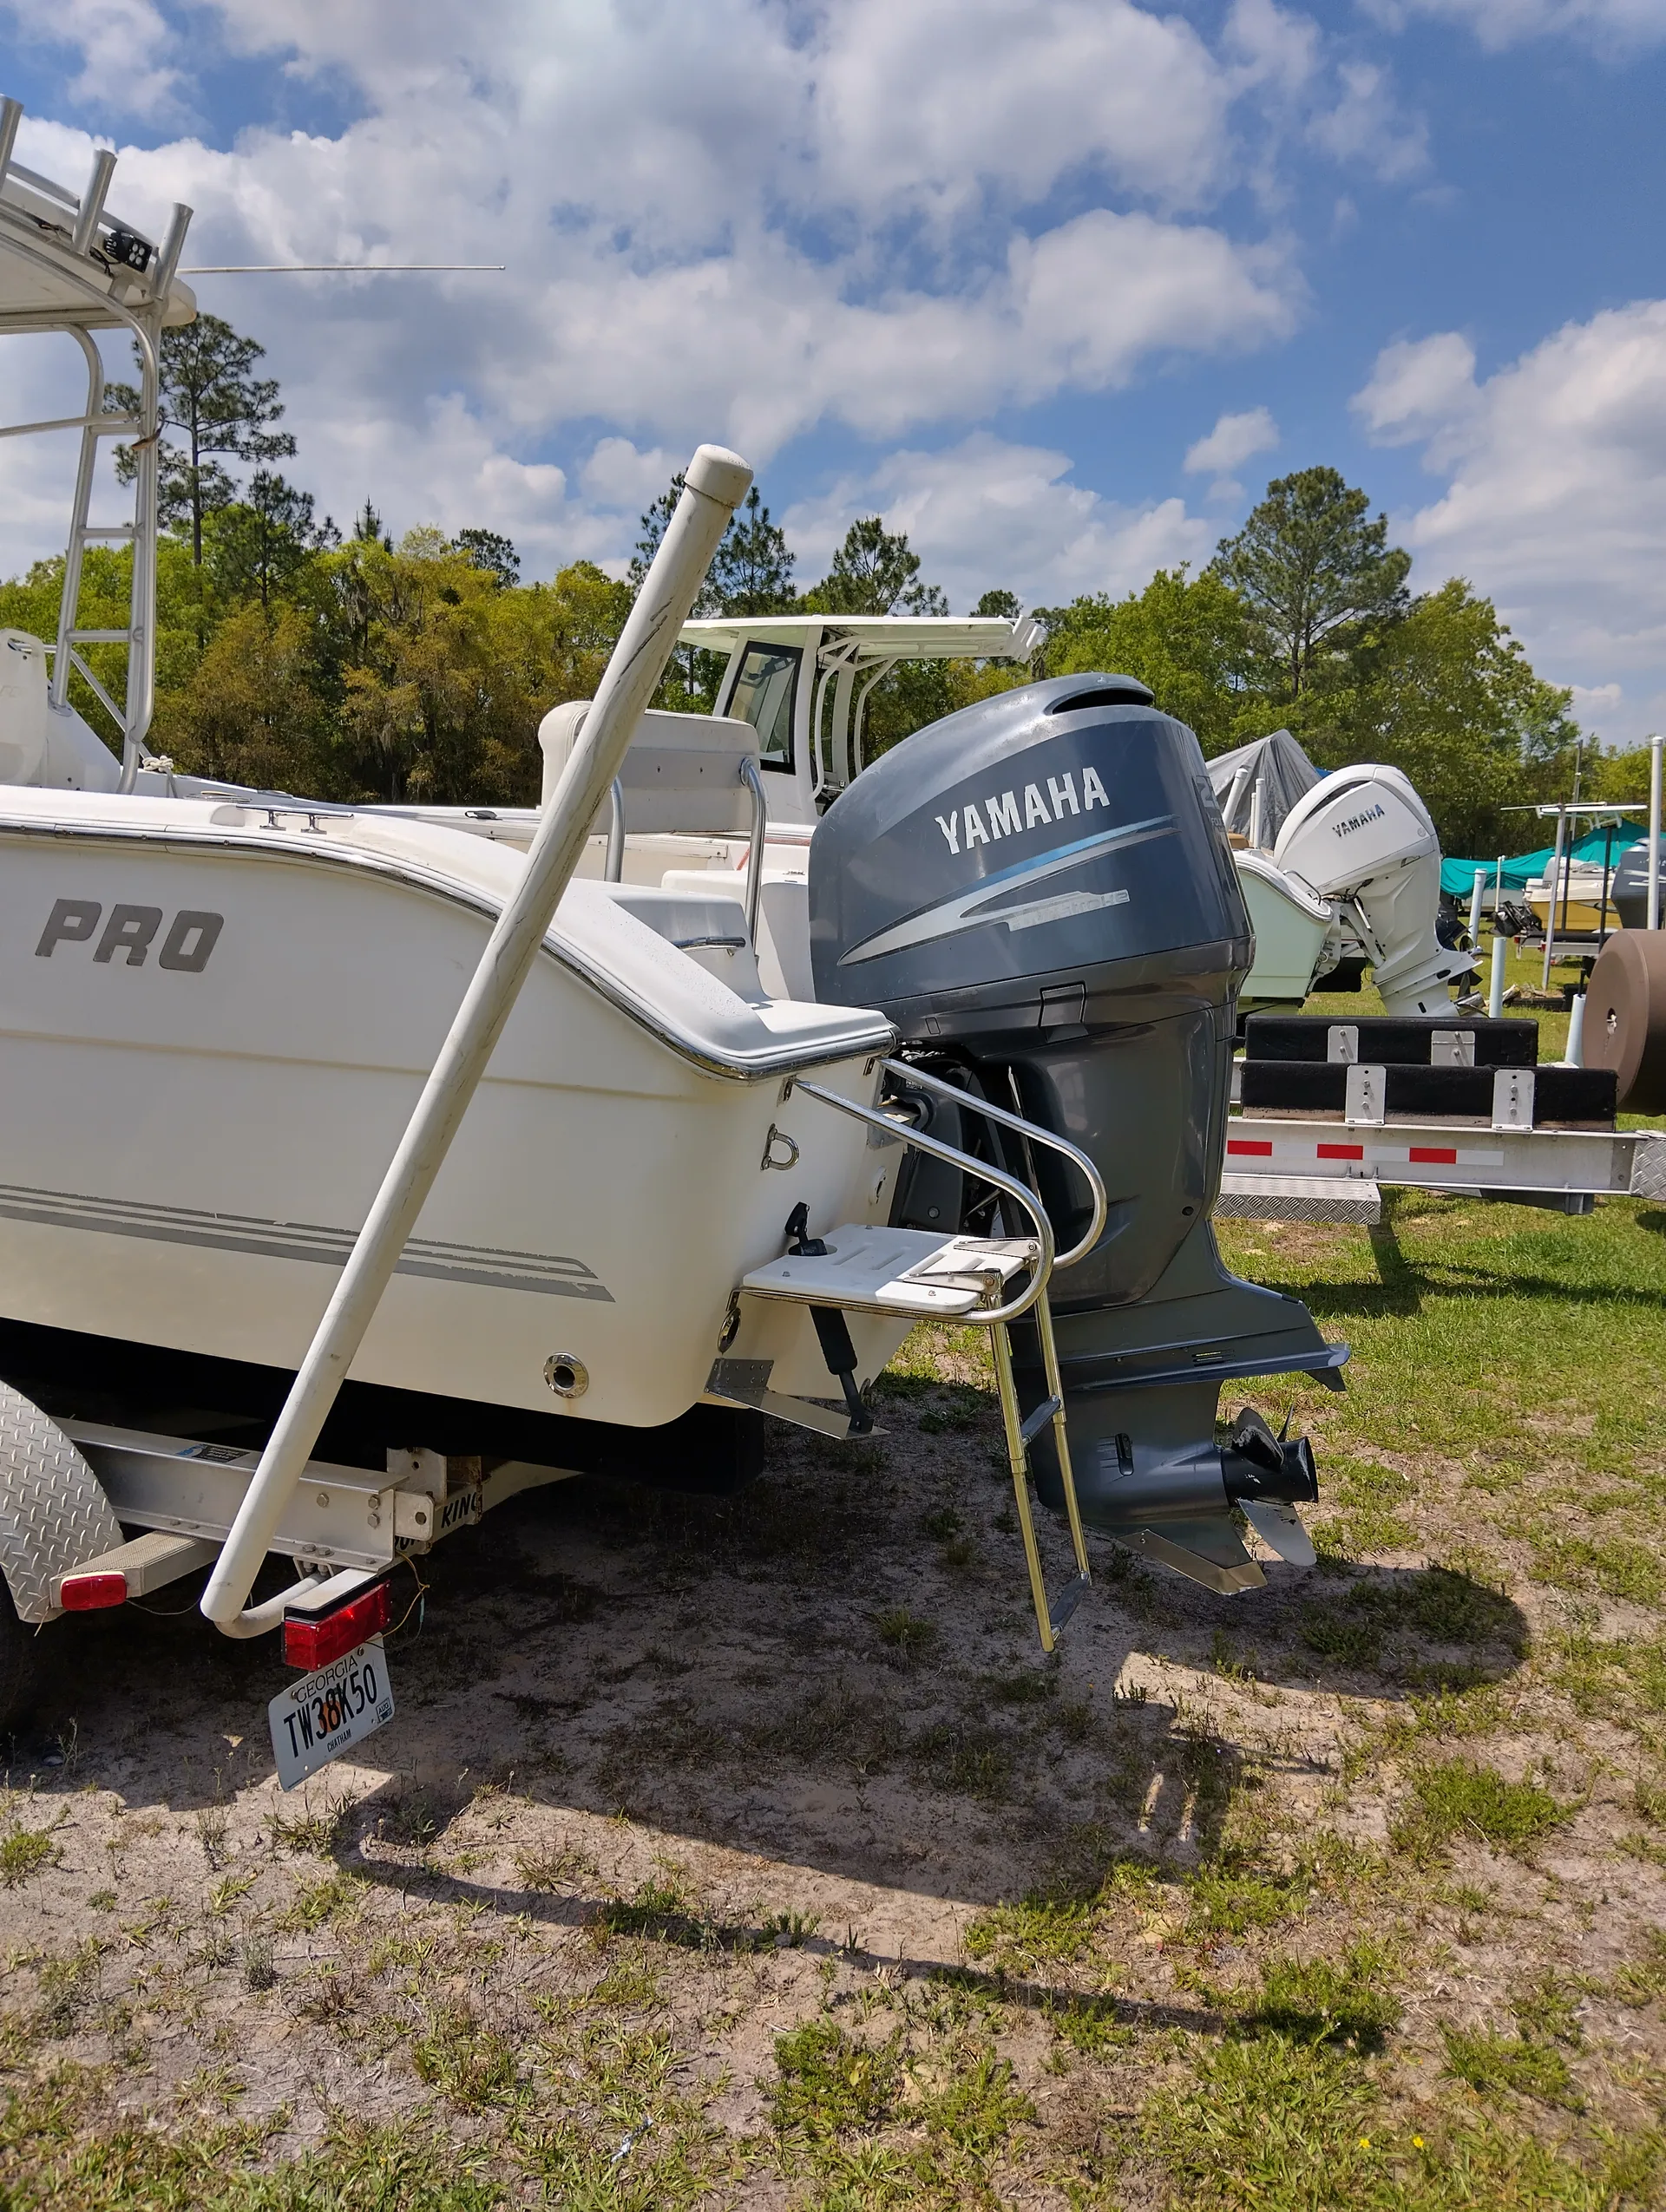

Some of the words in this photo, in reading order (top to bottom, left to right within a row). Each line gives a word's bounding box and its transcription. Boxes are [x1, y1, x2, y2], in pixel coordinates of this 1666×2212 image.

[935, 767, 1111, 855] YAMAHA
[1332, 803, 1386, 839] YAMAHA
[35, 899, 225, 973] PRO
[296, 1655, 357, 1704] GEORGIA
[284, 1663, 377, 1758] TW38K50
[326, 1728, 352, 1753] CHATHAM
